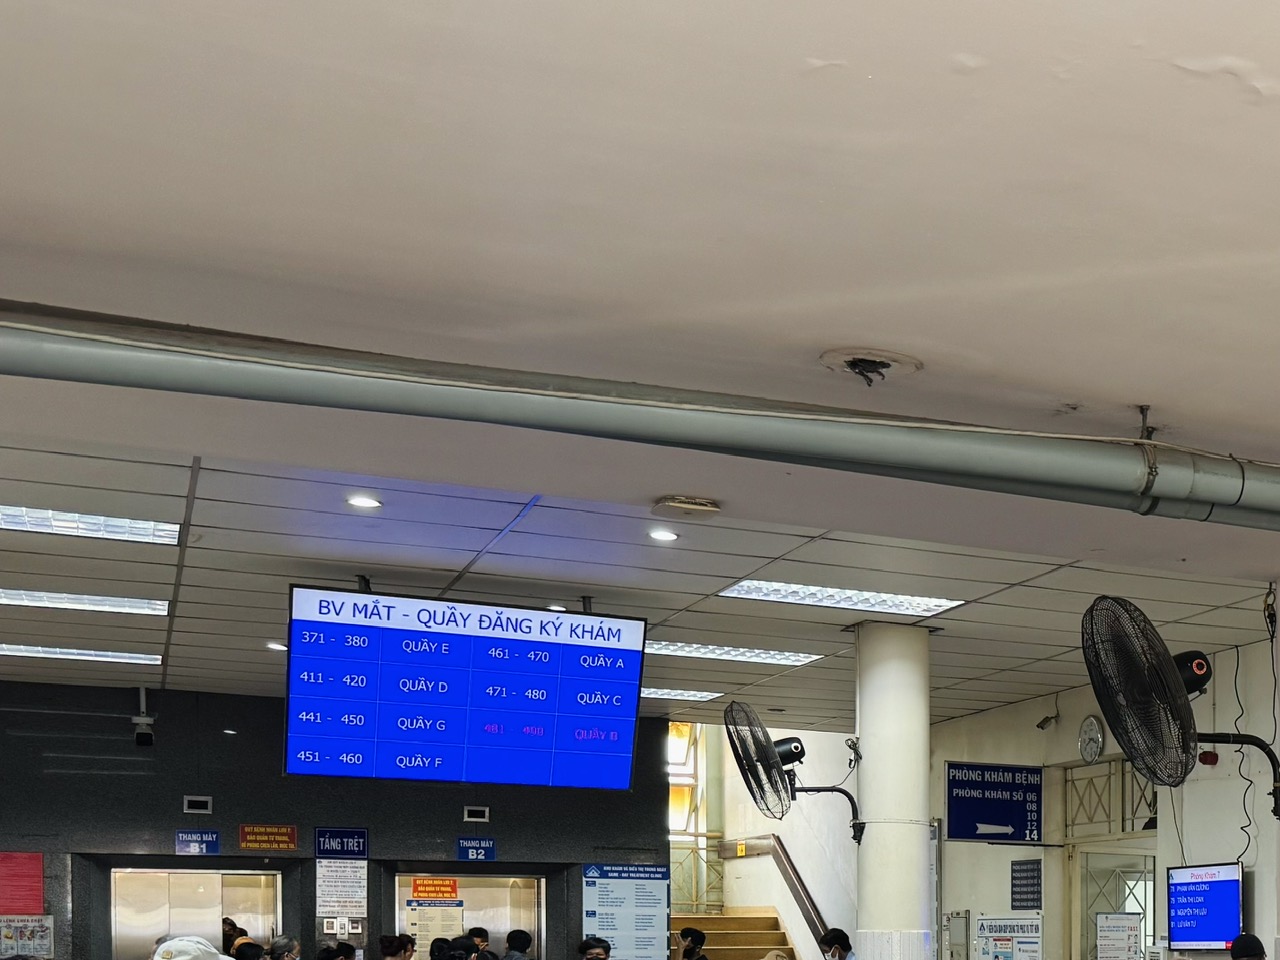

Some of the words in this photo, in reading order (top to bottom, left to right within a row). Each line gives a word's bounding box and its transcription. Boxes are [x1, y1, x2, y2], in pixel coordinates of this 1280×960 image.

[318, 599, 345, 616] BV
[352, 599, 396, 621] MẮT
[417, 605, 471, 629] QUẦY
[478, 610, 533, 634] ĐĂNG
[539, 616, 563, 637] KÝ
[569, 621, 622, 643] KHÁM
[301, 631, 326, 644] 371
[344, 635, 369, 648] 380
[402, 638, 438, 654] QUẦY
[441, 643, 450, 654] E
[488, 647, 510, 659] 461
[527, 651, 550, 663] 470
[580, 653, 613, 669] QUẦY
[615, 658, 625, 669] A
[299, 671, 324, 683] 411
[342, 674, 367, 687] 420
[399, 676, 435, 693] QUẦY
[438, 681, 448, 693] D
[485, 686, 508, 698] 471
[524, 689, 547, 700] 480
[577, 691, 610, 705] QUẦY
[612, 695, 622, 706] C
[298, 711, 322, 723] 441
[340, 714, 365, 726] 450
[397, 715, 433, 731] QUẦY
[436, 720, 446, 731] G
[297, 751, 320, 762] 451
[339, 753, 363, 765] 460
[396, 753, 431, 769] QUẦY
[434, 758, 443, 768] F
[949, 766, 982, 781] PHÒNG
[984, 768, 1013, 783] KHÁM
[1015, 770, 1041, 786] BỆNH
[953, 786, 983, 798] PHÒNG
[984, 788, 1010, 800] KHÁM
[1026, 792, 1037, 802] 06
[1026, 802, 1037, 811] 08
[1026, 812, 1037, 821] 10
[1026, 821, 1037, 830] 12
[178, 833, 201, 841] THANG
[319, 832, 342, 851] TẦNG
[343, 834, 365, 852] TRỆT
[460, 839, 480, 848] THANG
[480, 838, 494, 848] MÁY
[1024, 830, 1039, 841] 14
[189, 843, 207, 853] B1
[468, 848, 485, 860] B2
